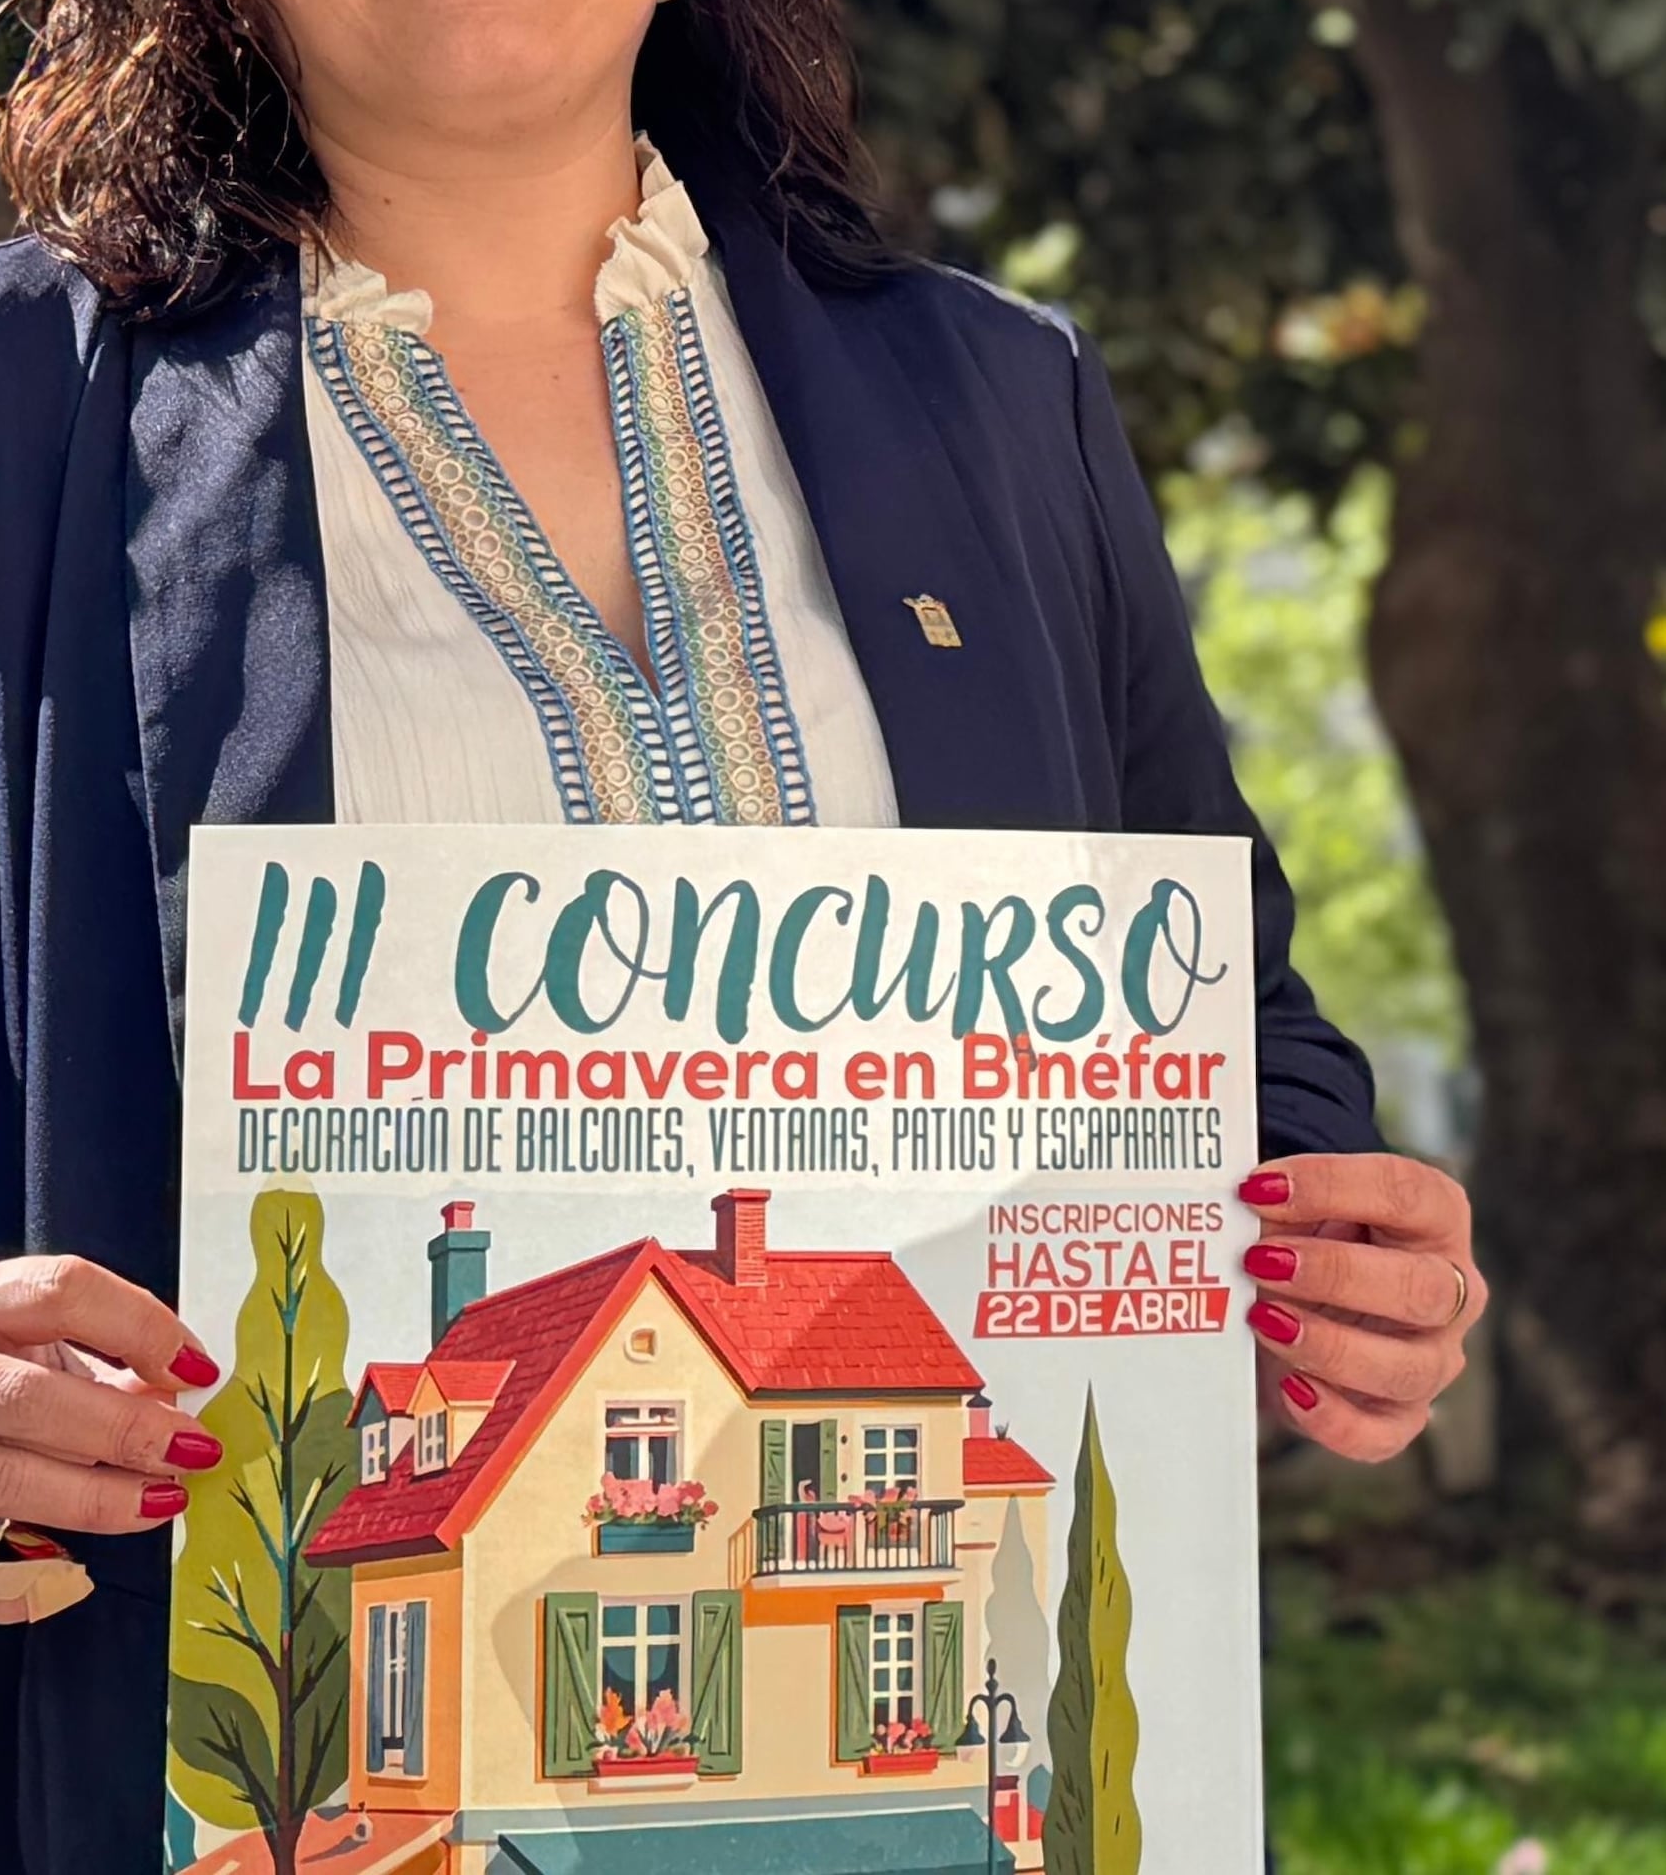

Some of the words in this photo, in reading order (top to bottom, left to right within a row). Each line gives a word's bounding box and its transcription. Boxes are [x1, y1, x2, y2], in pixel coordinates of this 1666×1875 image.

[236, 859, 387, 1033] III
[232, 1030, 336, 1102] La
[367, 1029, 819, 1102] Primavera
[844, 1049, 935, 1102] en
[962, 1031, 1227, 1102] Binéfar
[237, 1095, 450, 1174] DECORACIÓN
[462, 1106, 503, 1173] DE
[515, 1106, 696, 1179] BALCONES,
[707, 1105, 880, 1178] VENTANAS,
[892, 1105, 996, 1172] PATIOS
[1007, 1106, 1025, 1172] Y
[1035, 1105, 1223, 1172] ESCAPARATES
[988, 1202, 1224, 1235] INSCRIPCIONES
[987, 1239, 1158, 1289] HASTA
[1168, 1239, 1220, 1285] EL
[986, 1294, 1041, 1335] 22
[1049, 1292, 1103, 1334] DE
[1110, 1290, 1220, 1333] ABRIL
